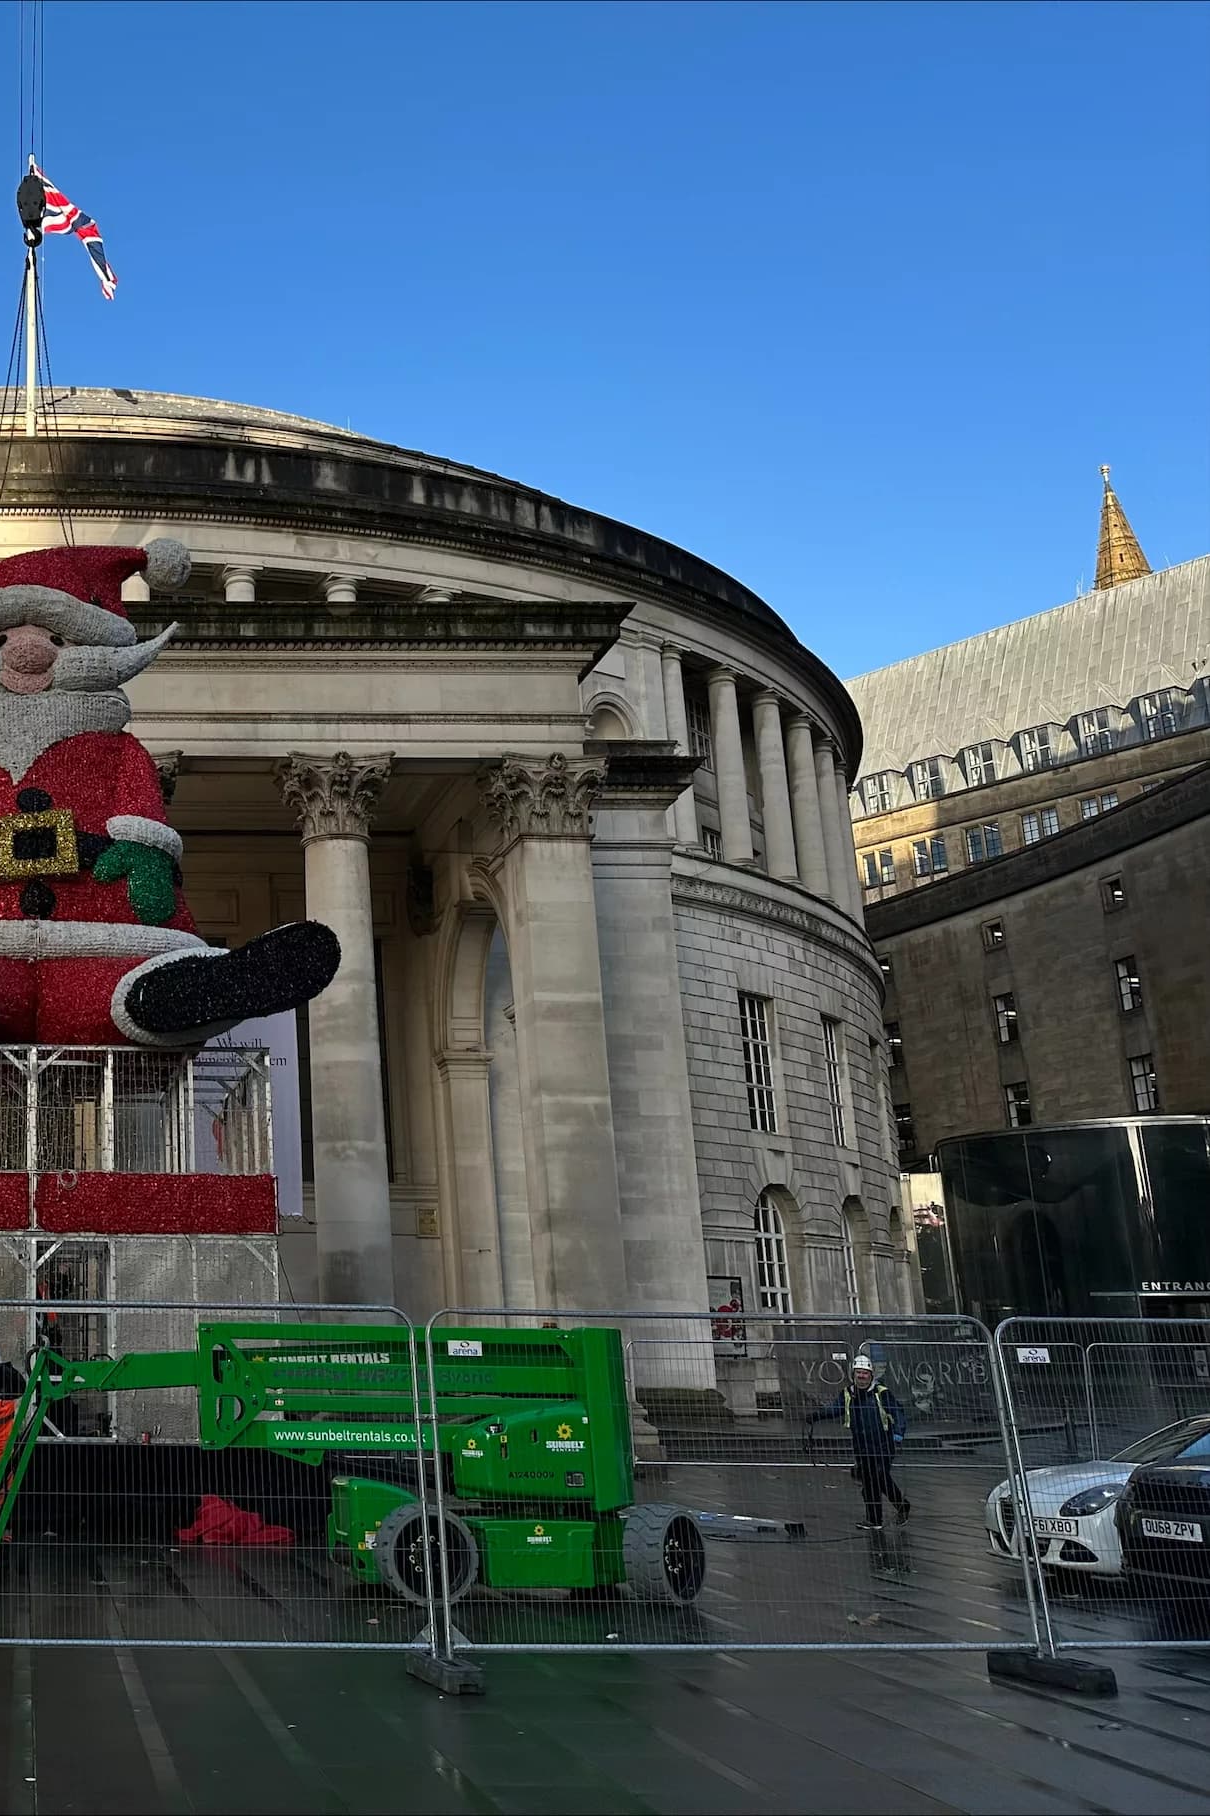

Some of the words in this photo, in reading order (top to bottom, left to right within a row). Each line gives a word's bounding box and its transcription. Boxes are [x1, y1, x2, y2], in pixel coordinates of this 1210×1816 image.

[330, 1352, 390, 1364] RENTALS
[1022, 1354, 1046, 1362] arena
[274, 1429, 426, 1444] www.sunbeltrentals.co.uk
[1173, 1522, 1195, 1537] ZPV
